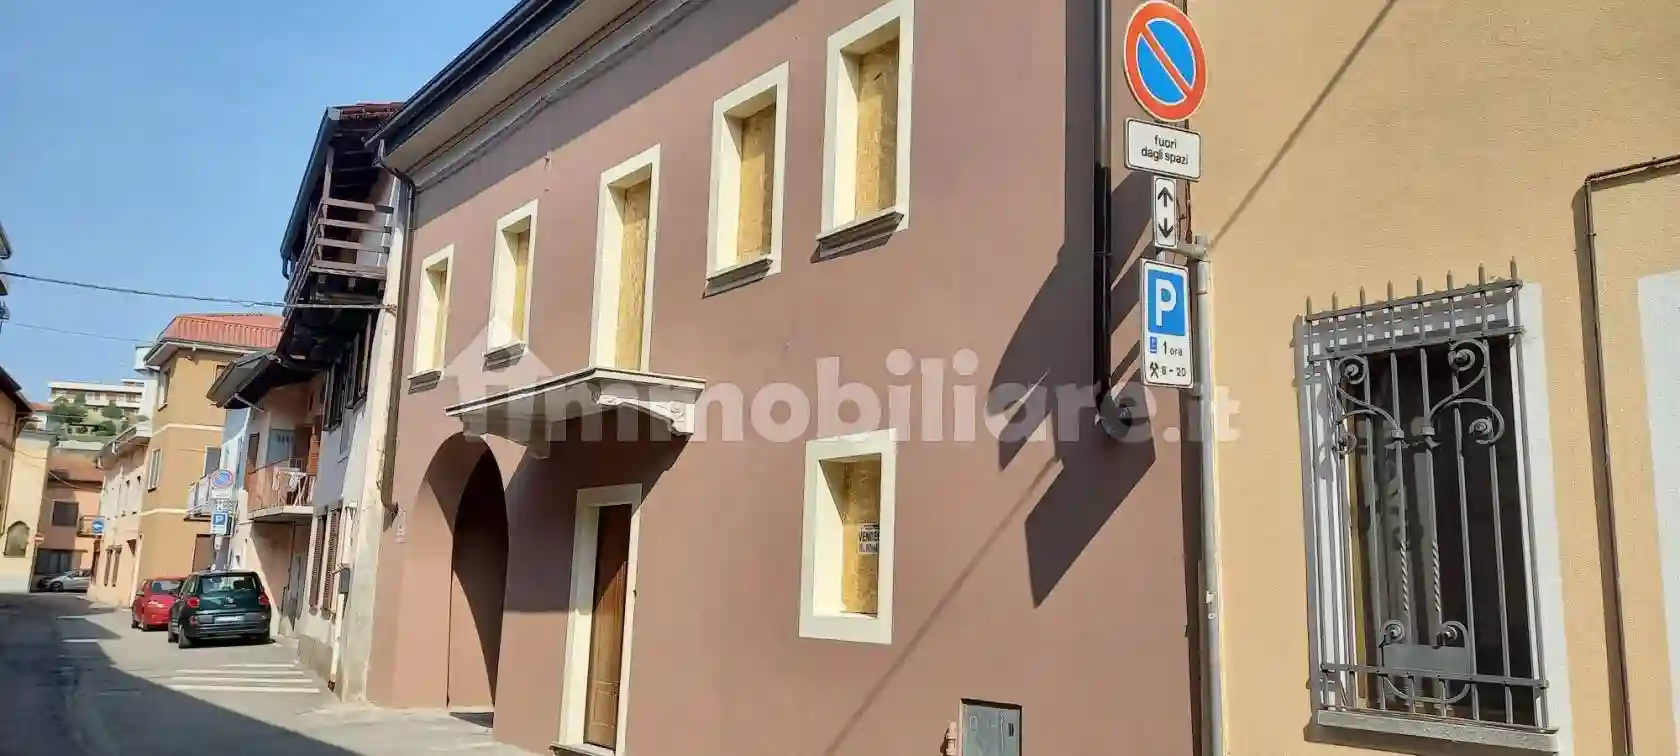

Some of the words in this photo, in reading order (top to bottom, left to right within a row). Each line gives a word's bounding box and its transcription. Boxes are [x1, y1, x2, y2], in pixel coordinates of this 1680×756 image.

[1154, 134, 1177, 149] fuori
[1140, 145, 1164, 162] dagli
[1165, 152, 1189, 165] spazi
[1155, 278, 1177, 327] P
[1162, 340, 1168, 355] 1
[1169, 347, 1183, 356] ora
[1176, 367, 1187, 377] 20
[214, 514, 225, 526] P
